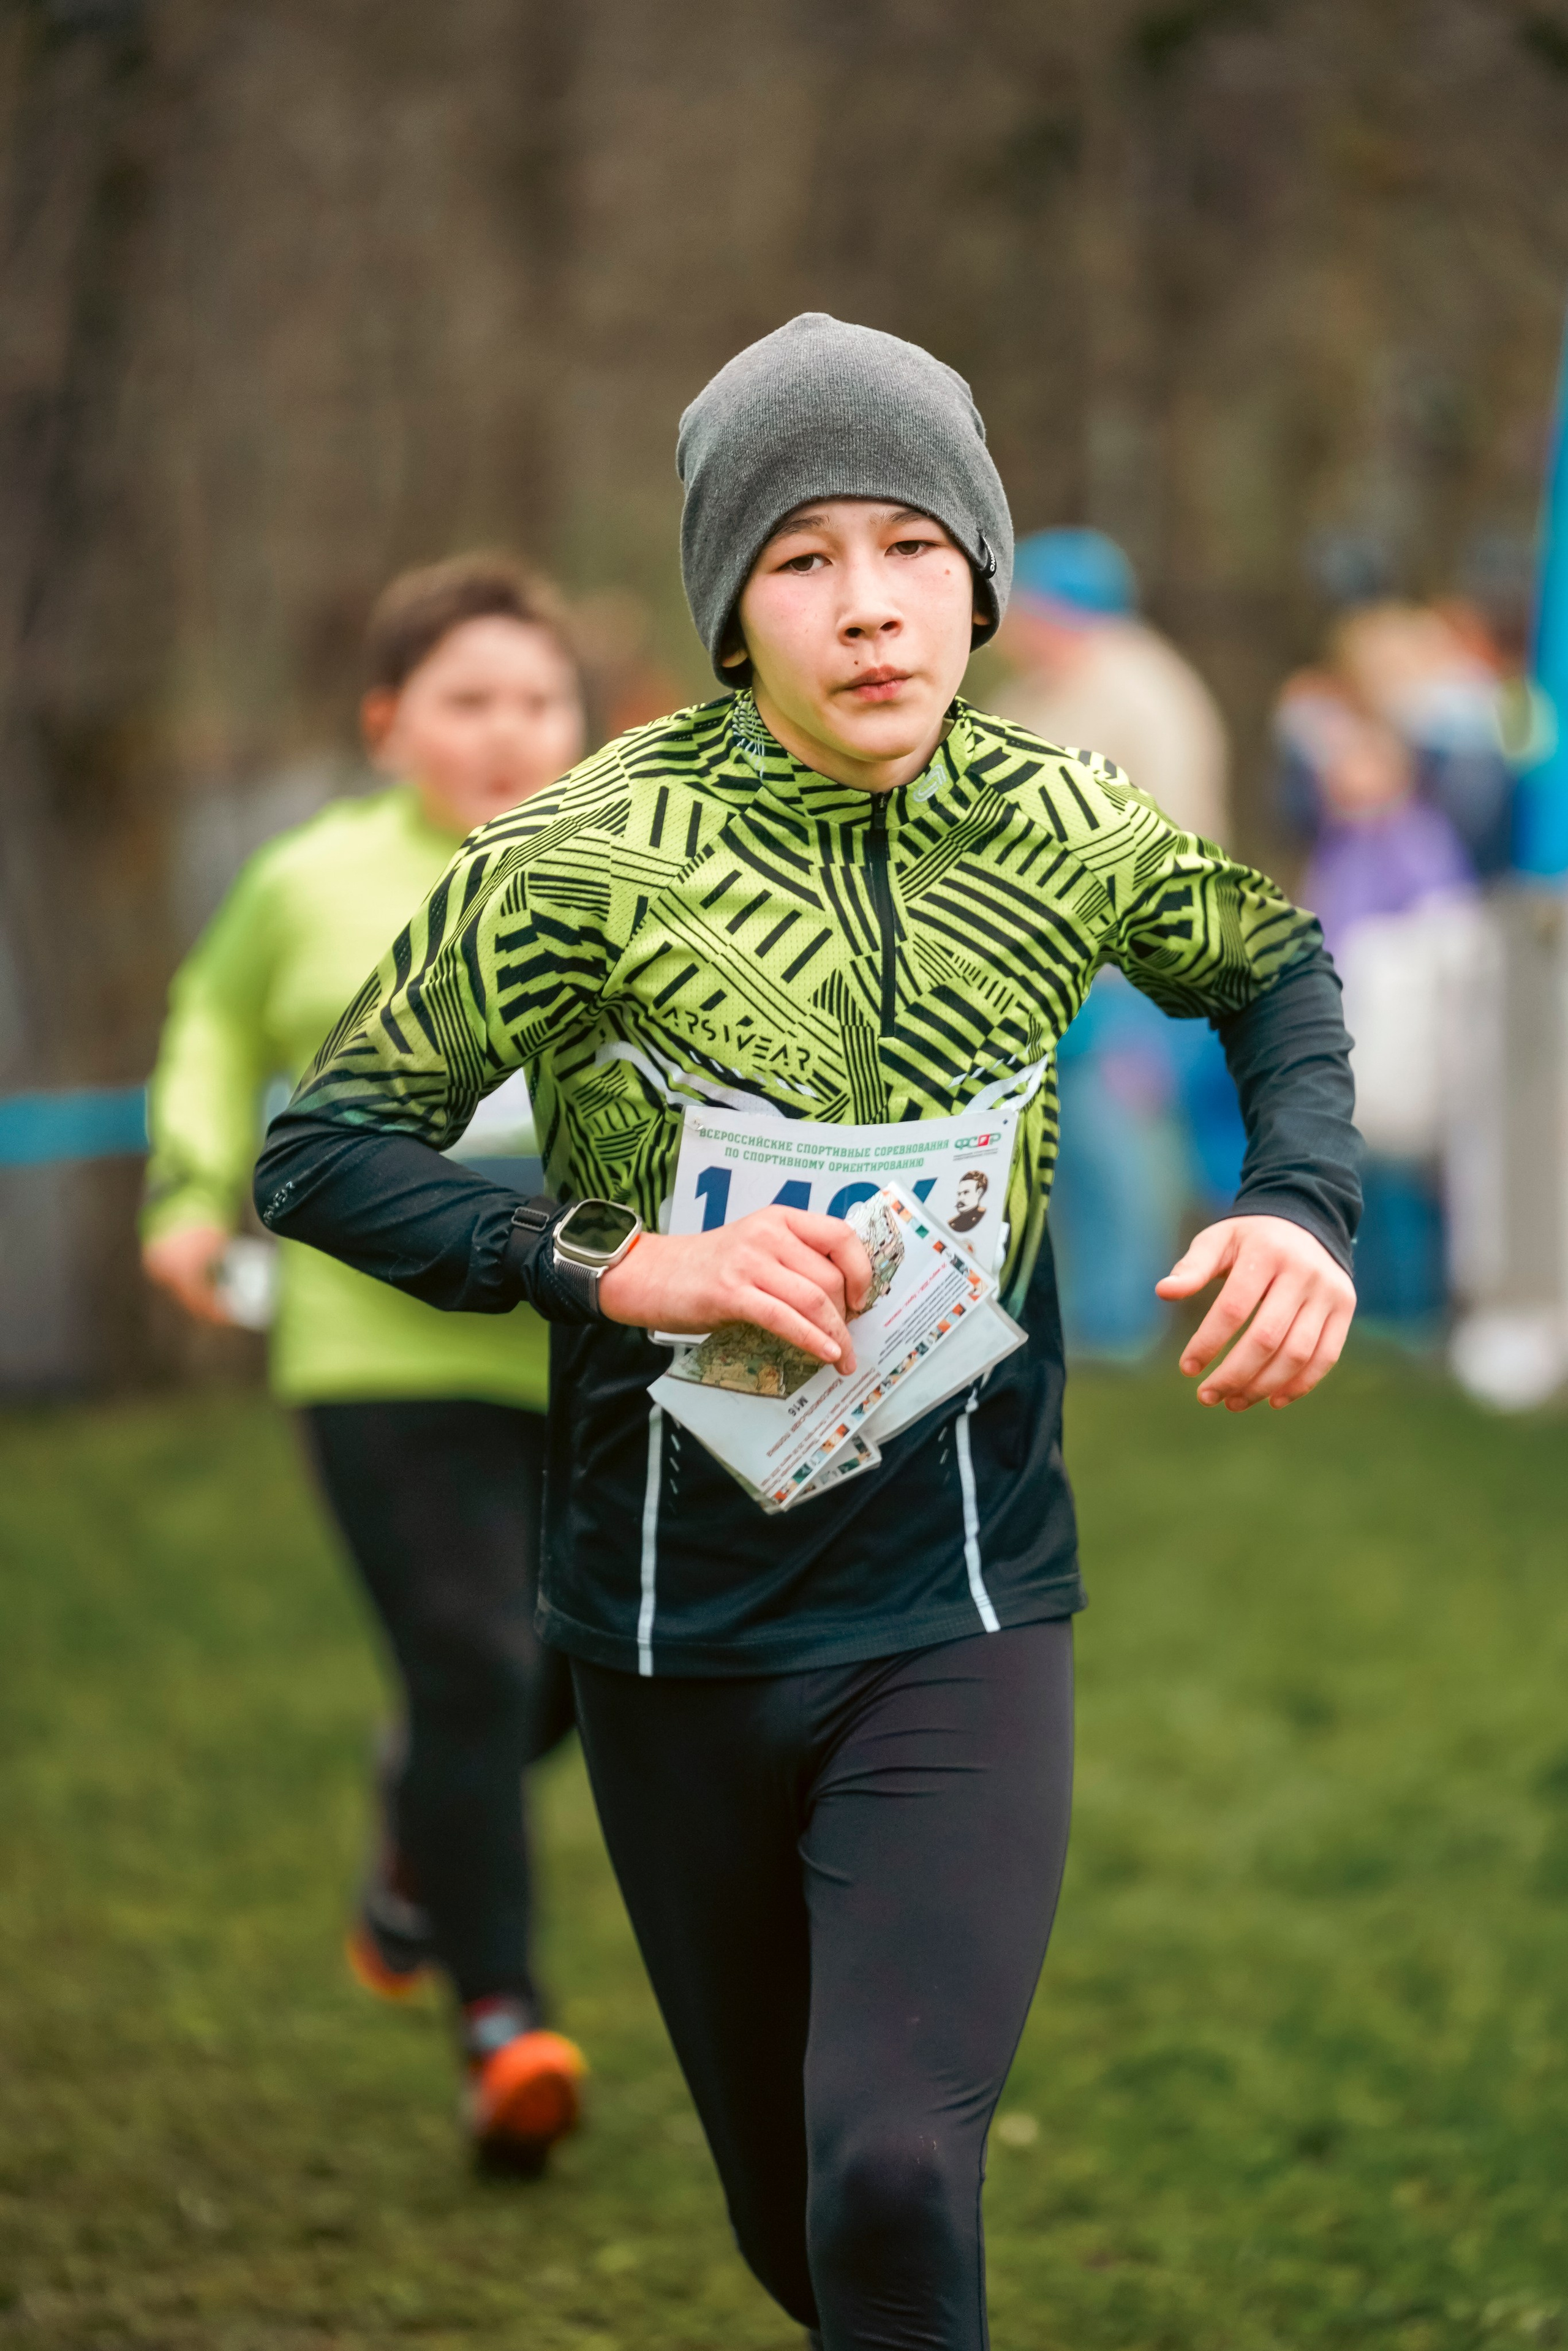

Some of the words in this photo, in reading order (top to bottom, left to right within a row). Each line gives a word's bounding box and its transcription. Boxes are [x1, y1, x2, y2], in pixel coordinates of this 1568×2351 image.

[699, 1128, 793, 1152] ВСЕРОССИЙСКИЕ
[796, 1142, 870, 1158] СПОРТИВНЫЕ
[873, 1139, 949, 1157] СОРЕВНОВАНИЯ
[725, 1147, 739, 1158] ПО
[743, 1150, 825, 1170] СПОРТИВНОМУ
[829, 1157, 924, 1172] ОРИЕНТИРОВАНИЮ
